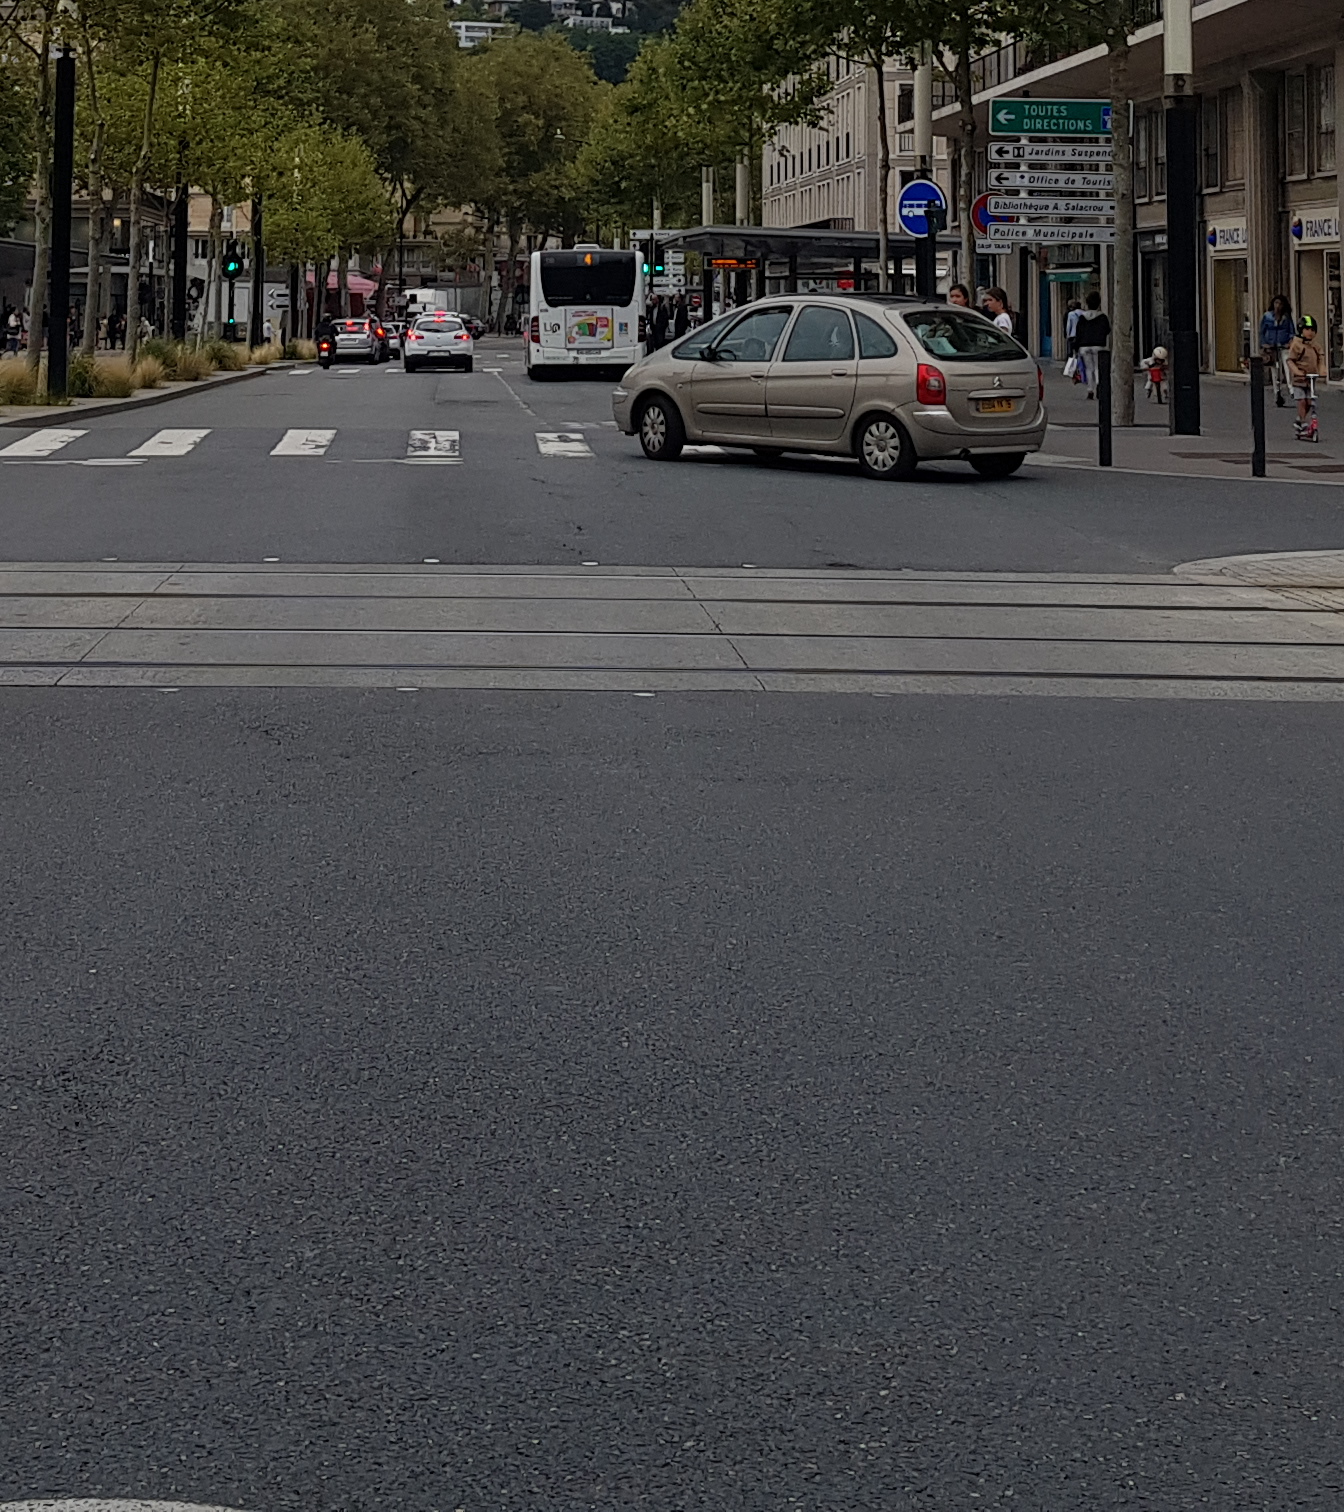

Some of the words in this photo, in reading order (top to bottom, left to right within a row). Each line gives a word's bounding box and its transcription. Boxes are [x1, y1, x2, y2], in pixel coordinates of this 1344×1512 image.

[1024, 105, 1067, 116] TOUTES
[1023, 119, 1093, 130] DIRECTIONS
[1028, 148, 1066, 157] Jardins
[1028, 175, 1059, 184] Office
[1064, 175, 1076, 185] de
[1082, 177, 1111, 186] Touris
[994, 201, 1049, 212] Bibliothèque
[1064, 202, 1104, 212] Salacrou
[1306, 219, 1331, 238] FRANCE
[994, 229, 1027, 237] Police
[1033, 229, 1094, 240] Municipale
[1219, 228, 1239, 245] FRANCE
